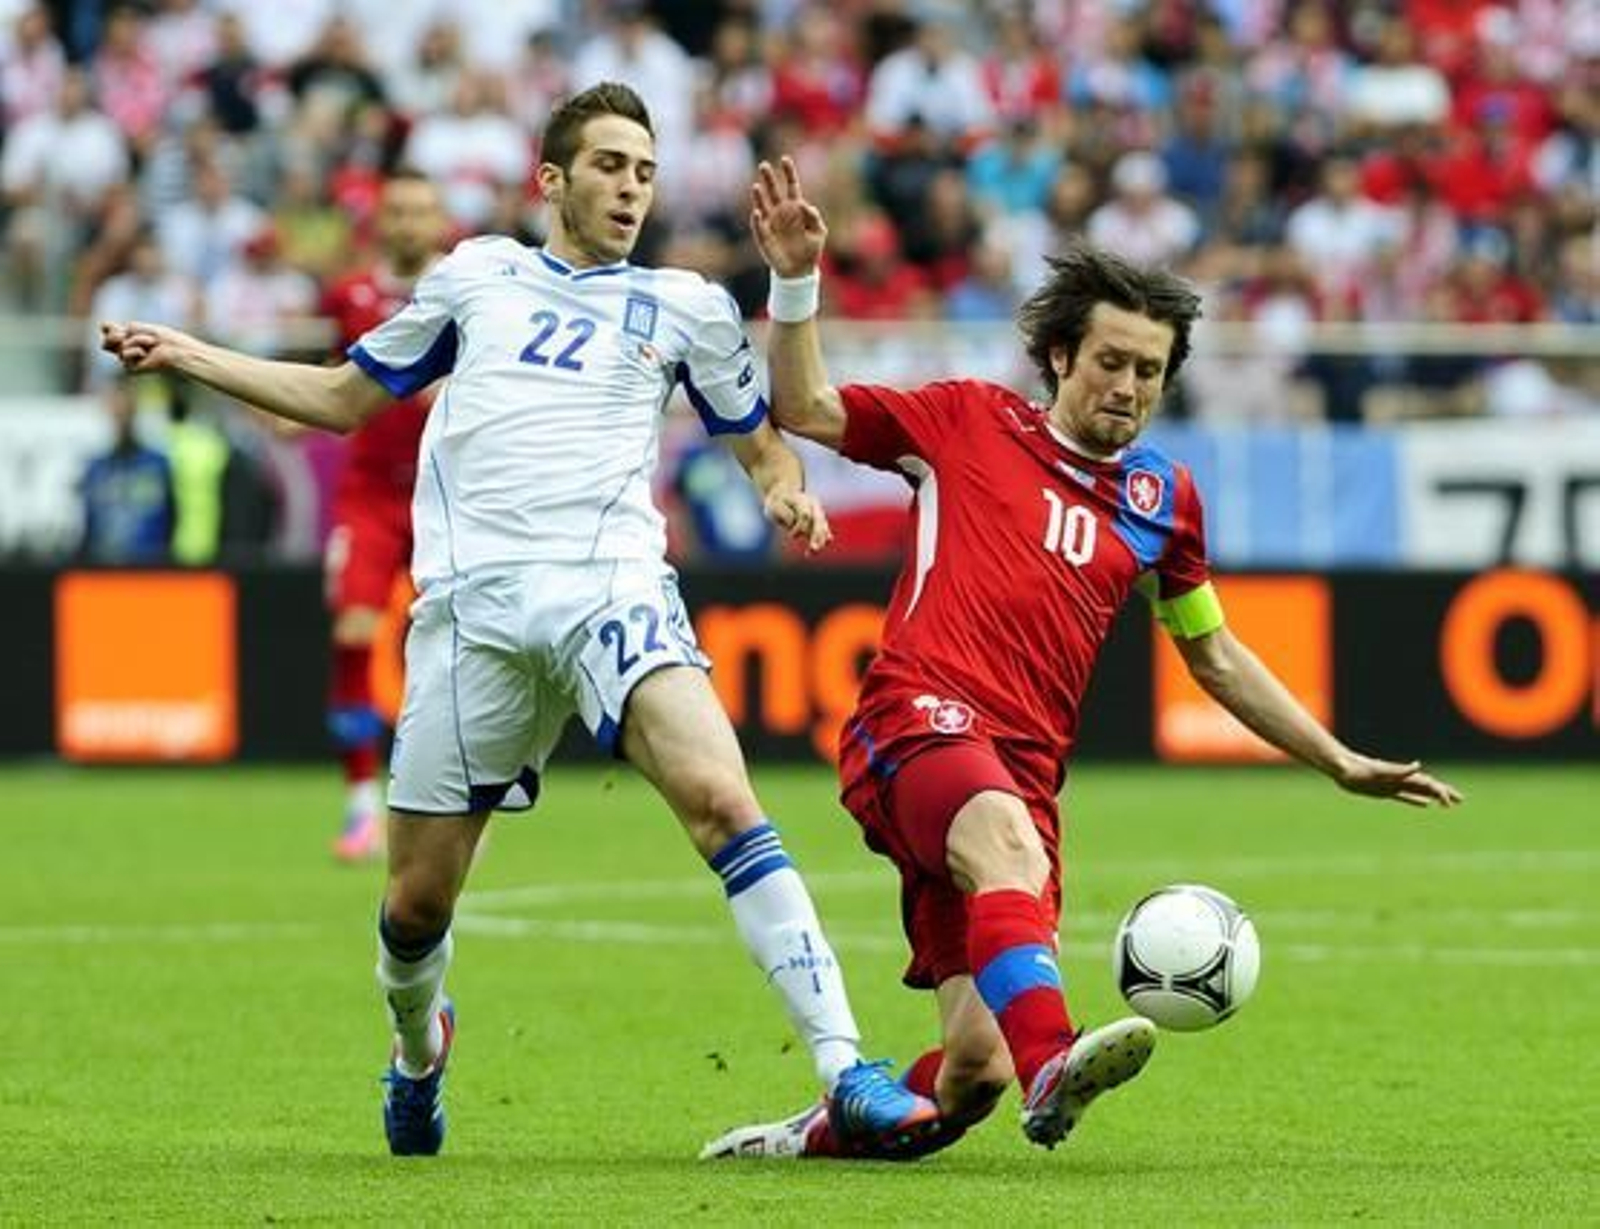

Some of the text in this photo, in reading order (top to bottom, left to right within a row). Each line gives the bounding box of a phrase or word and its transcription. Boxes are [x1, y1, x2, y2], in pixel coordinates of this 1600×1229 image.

[519, 309, 596, 371] 22
[1041, 487, 1099, 567] 10
[598, 604, 667, 676] 22
